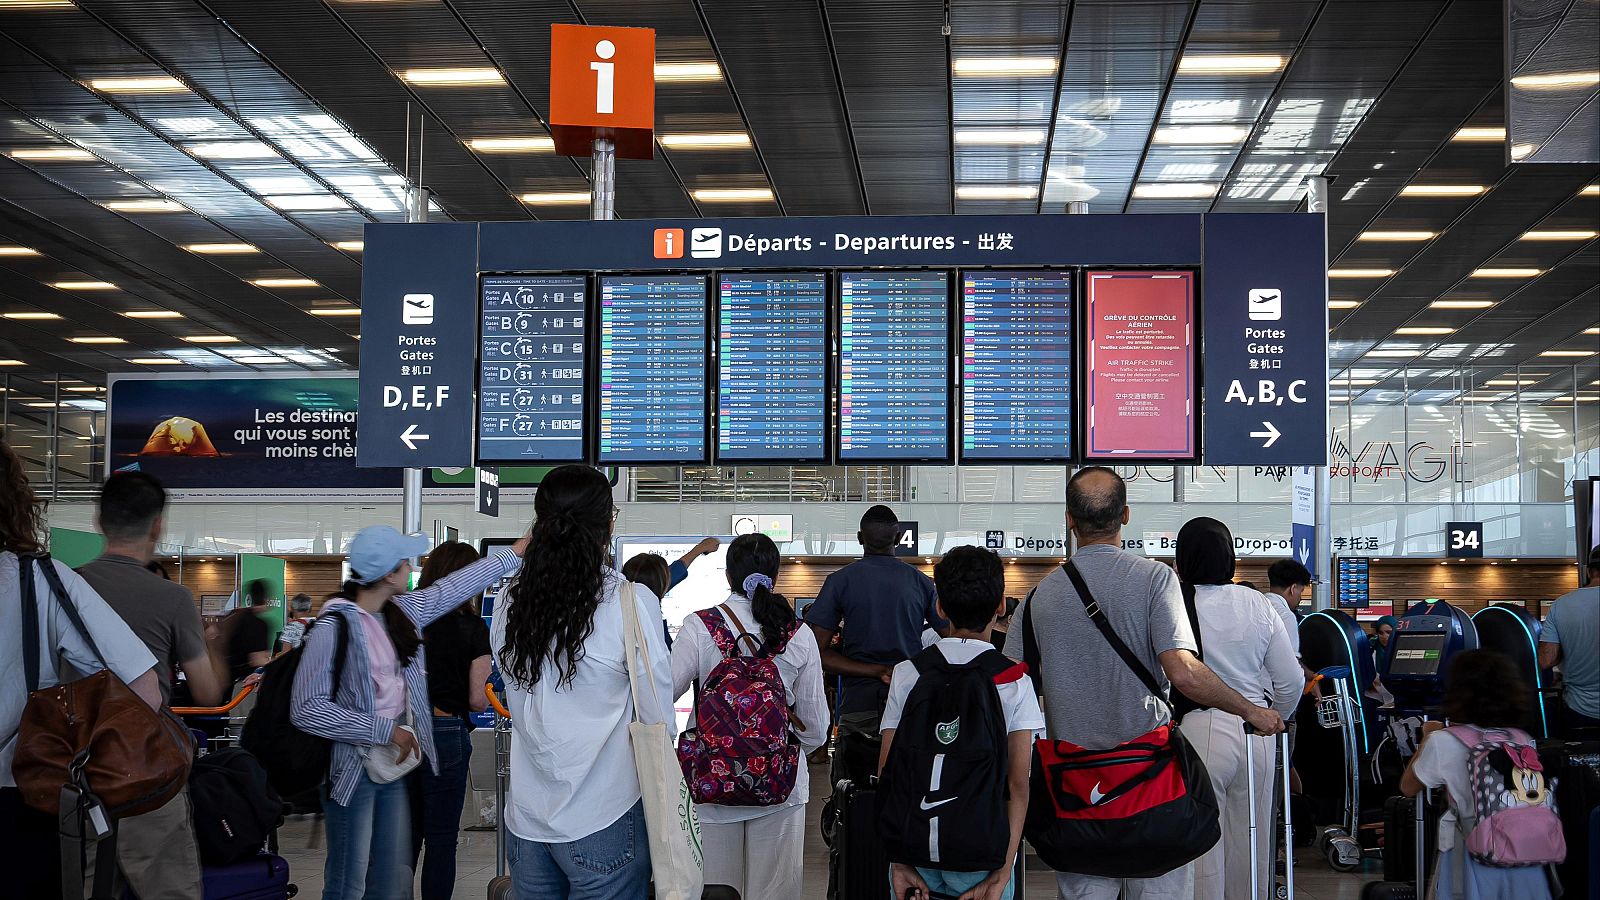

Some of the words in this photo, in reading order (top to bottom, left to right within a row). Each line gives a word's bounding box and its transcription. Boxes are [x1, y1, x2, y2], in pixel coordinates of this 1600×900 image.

[729, 234, 811, 255] Départs
[836, 232, 955, 254] Departures
[979, 232, 1014, 250] 出发
[501, 292, 513, 304] A
[521, 295, 534, 304] 10
[501, 317, 512, 329] B
[520, 320, 528, 329] 9
[1245, 327, 1286, 339] Portes
[398, 335, 437, 346] Portes
[500, 342, 512, 355] C
[520, 345, 533, 355] 15
[1247, 342, 1284, 354] Gates
[399, 349, 434, 361] Gates
[1249, 358, 1282, 370] 登机口
[401, 365, 432, 376] 登机口
[499, 368, 511, 380] D
[520, 371, 533, 380] 31
[383, 385, 450, 411] D,E,F
[1224, 379, 1307, 406] A,B,C
[500, 392, 510, 406] E
[519, 396, 534, 406] 27
[255, 407, 285, 423] Les
[290, 407, 358, 423] destina
[500, 419, 509, 432] F
[518, 421, 533, 431] 27
[234, 426, 261, 443] qui
[266, 429, 307, 441] vous
[312, 427, 351, 441] sont
[265, 443, 318, 458] moins
[1254, 466, 1292, 477] PARI
[1233, 537, 1294, 553] Drop-of
[1330, 536, 1379, 550] 李托运
[1451, 529, 1480, 550] 34
[665, 549, 669, 557] 3
[1424, 604, 1435, 615] 7
[1396, 620, 1410, 630] 31
